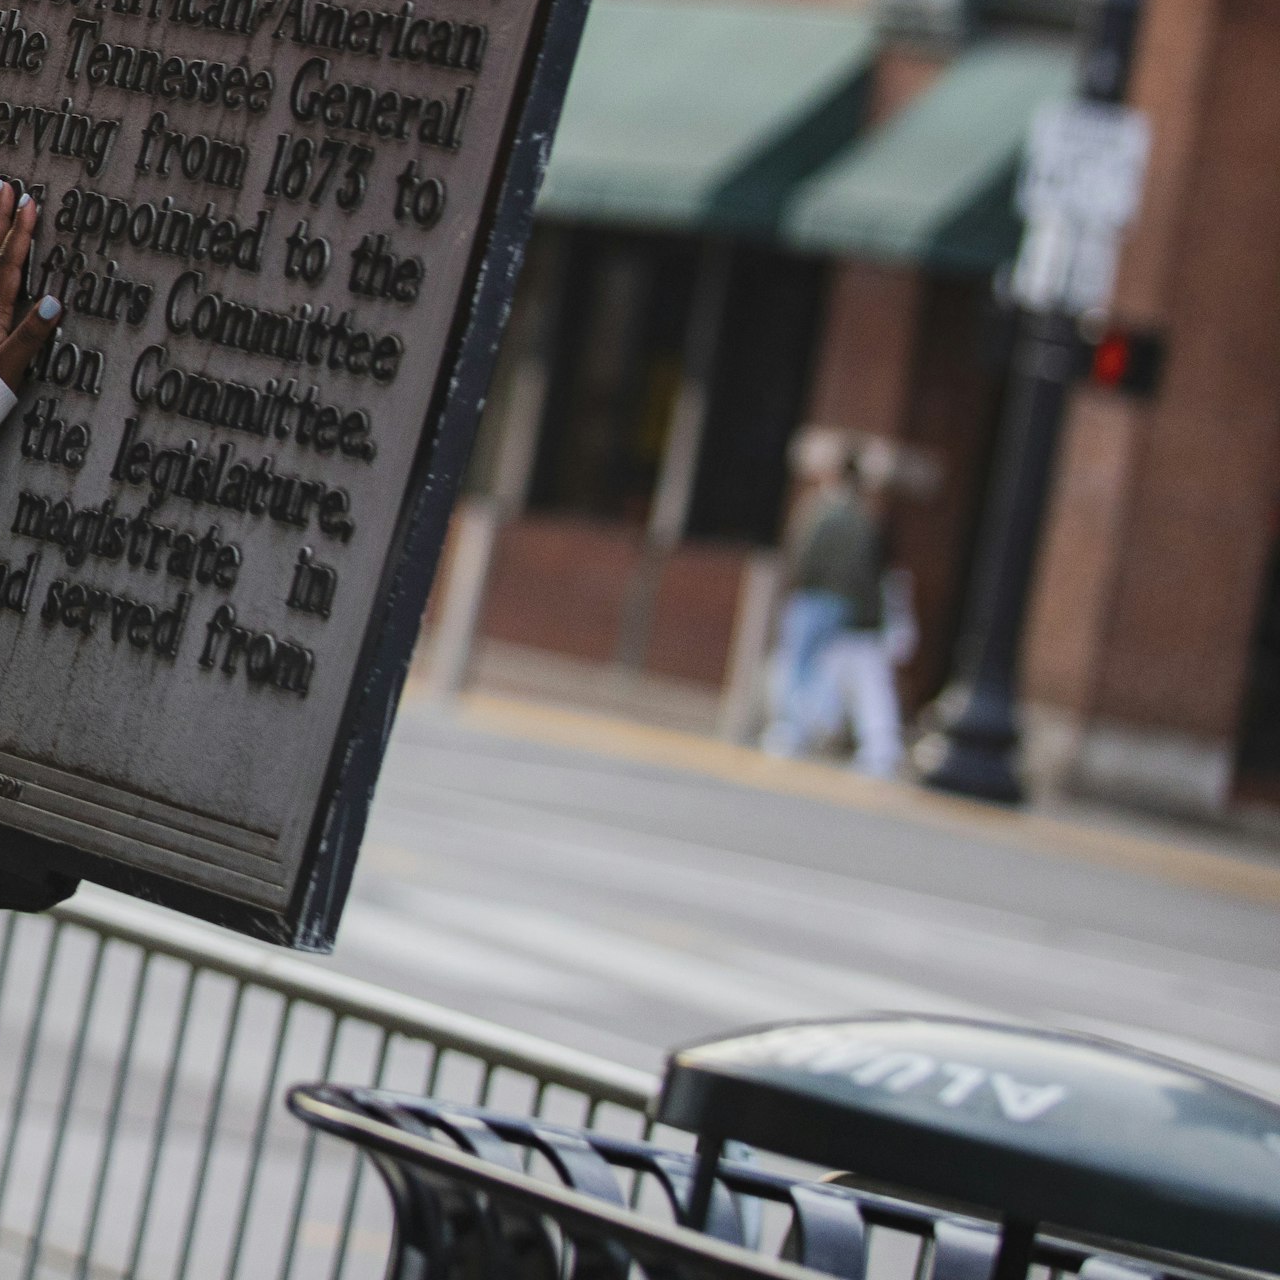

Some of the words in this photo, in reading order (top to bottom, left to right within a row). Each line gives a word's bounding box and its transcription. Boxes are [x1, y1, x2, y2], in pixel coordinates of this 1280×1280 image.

[66, 16, 274, 116] Tennessee
[289, 55, 473, 151] General
[134, 109, 249, 190] from
[263, 132, 375, 213] 1873
[393, 158, 446, 230] to
[53, 186, 272, 275] appointed
[284, 219, 332, 284] to
[348, 232, 426, 303] the
[165, 269, 405, 385] Committee
[20, 396, 91, 469] the
[109, 416, 356, 546] legislature,
[10, 490, 242, 589] magistrate
[285, 544, 338, 621] in
[41, 577, 193, 658] served
[198, 602, 316, 698] from
